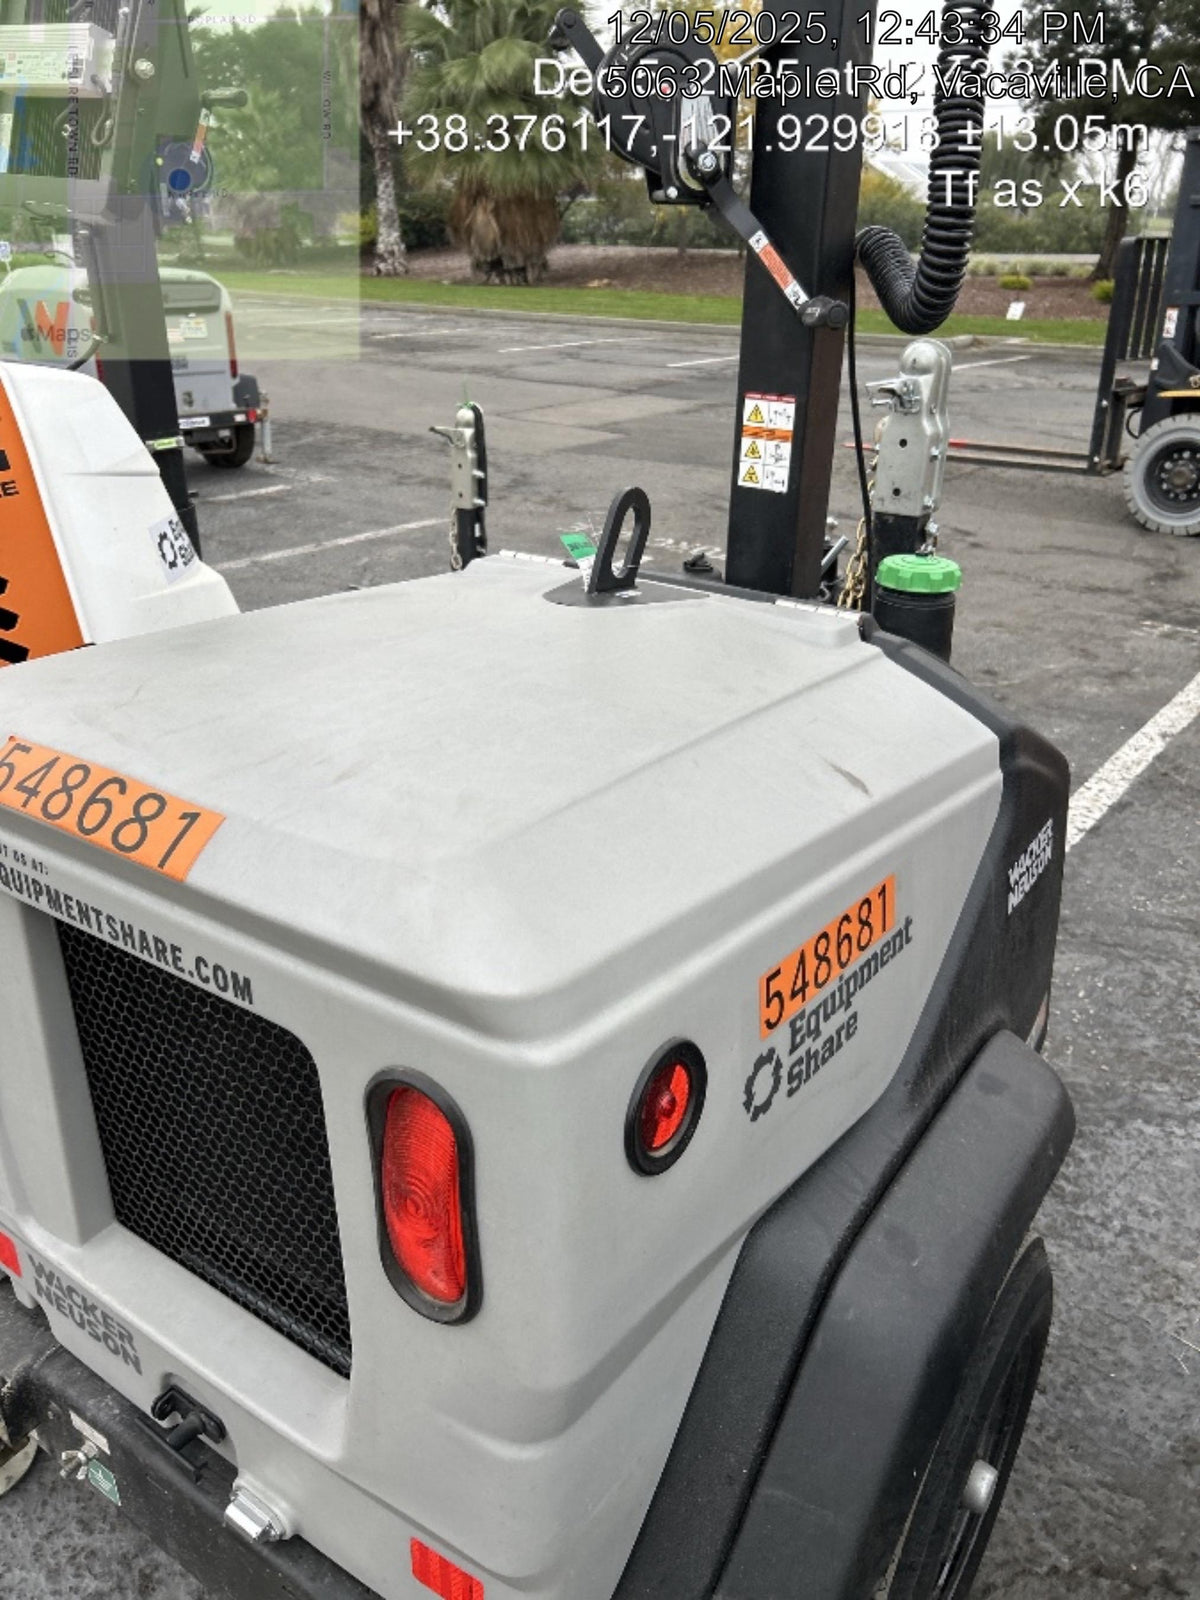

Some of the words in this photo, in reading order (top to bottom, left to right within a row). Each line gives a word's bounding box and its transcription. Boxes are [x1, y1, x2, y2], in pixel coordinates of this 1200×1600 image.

[0, 742, 202, 870] 548681
[763, 883, 887, 1031] 548681
[788, 915, 914, 1057] Equipment
[787, 1011, 859, 1098] Share
[28, 1254, 138, 1354] WACKER
[35, 1276, 143, 1376] NEUSON
